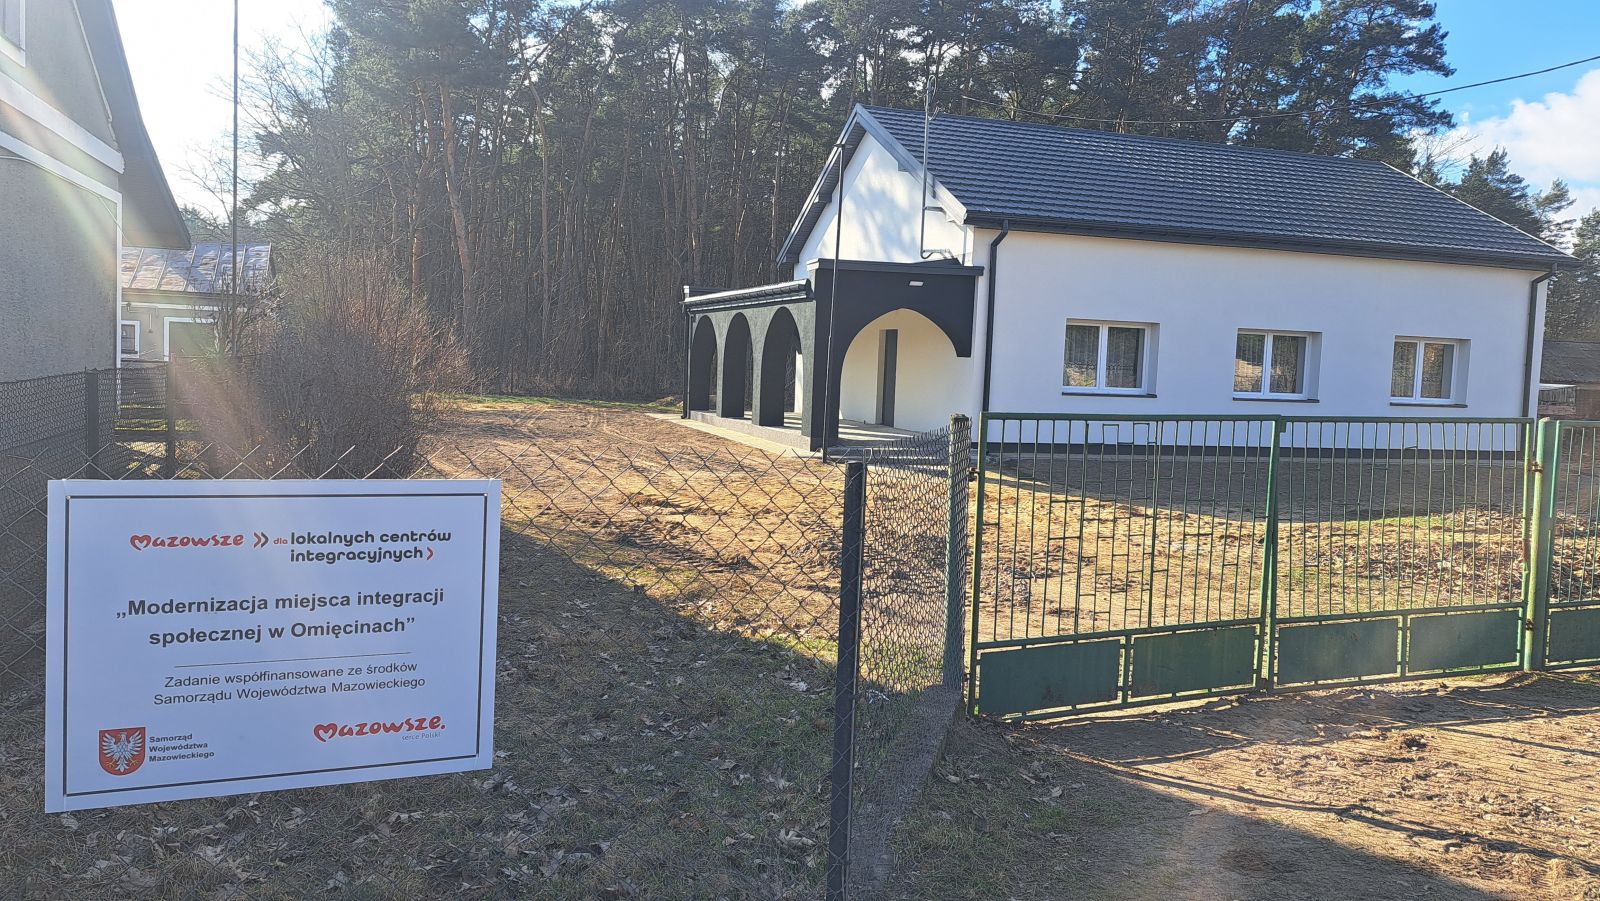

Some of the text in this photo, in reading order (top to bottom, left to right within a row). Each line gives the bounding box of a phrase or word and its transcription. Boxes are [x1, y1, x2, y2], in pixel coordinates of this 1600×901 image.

[130, 529, 451, 550] Mazowsze dla lokalnych centrów
[290, 546, 423, 564] integracyjnych
[116, 588, 444, 618] „Modernizacja miejsca integracji
[149, 617, 415, 648] społecznej w Omięcinach”
[165, 662, 418, 688] Zadanie współfinansowane ze środków
[154, 677, 426, 705] Samorządu Województwa Mazowieckiego
[149, 733, 192, 744] Samorząd
[149, 742, 208, 754] Województwa
[149, 750, 215, 762] Mazowieckiego
